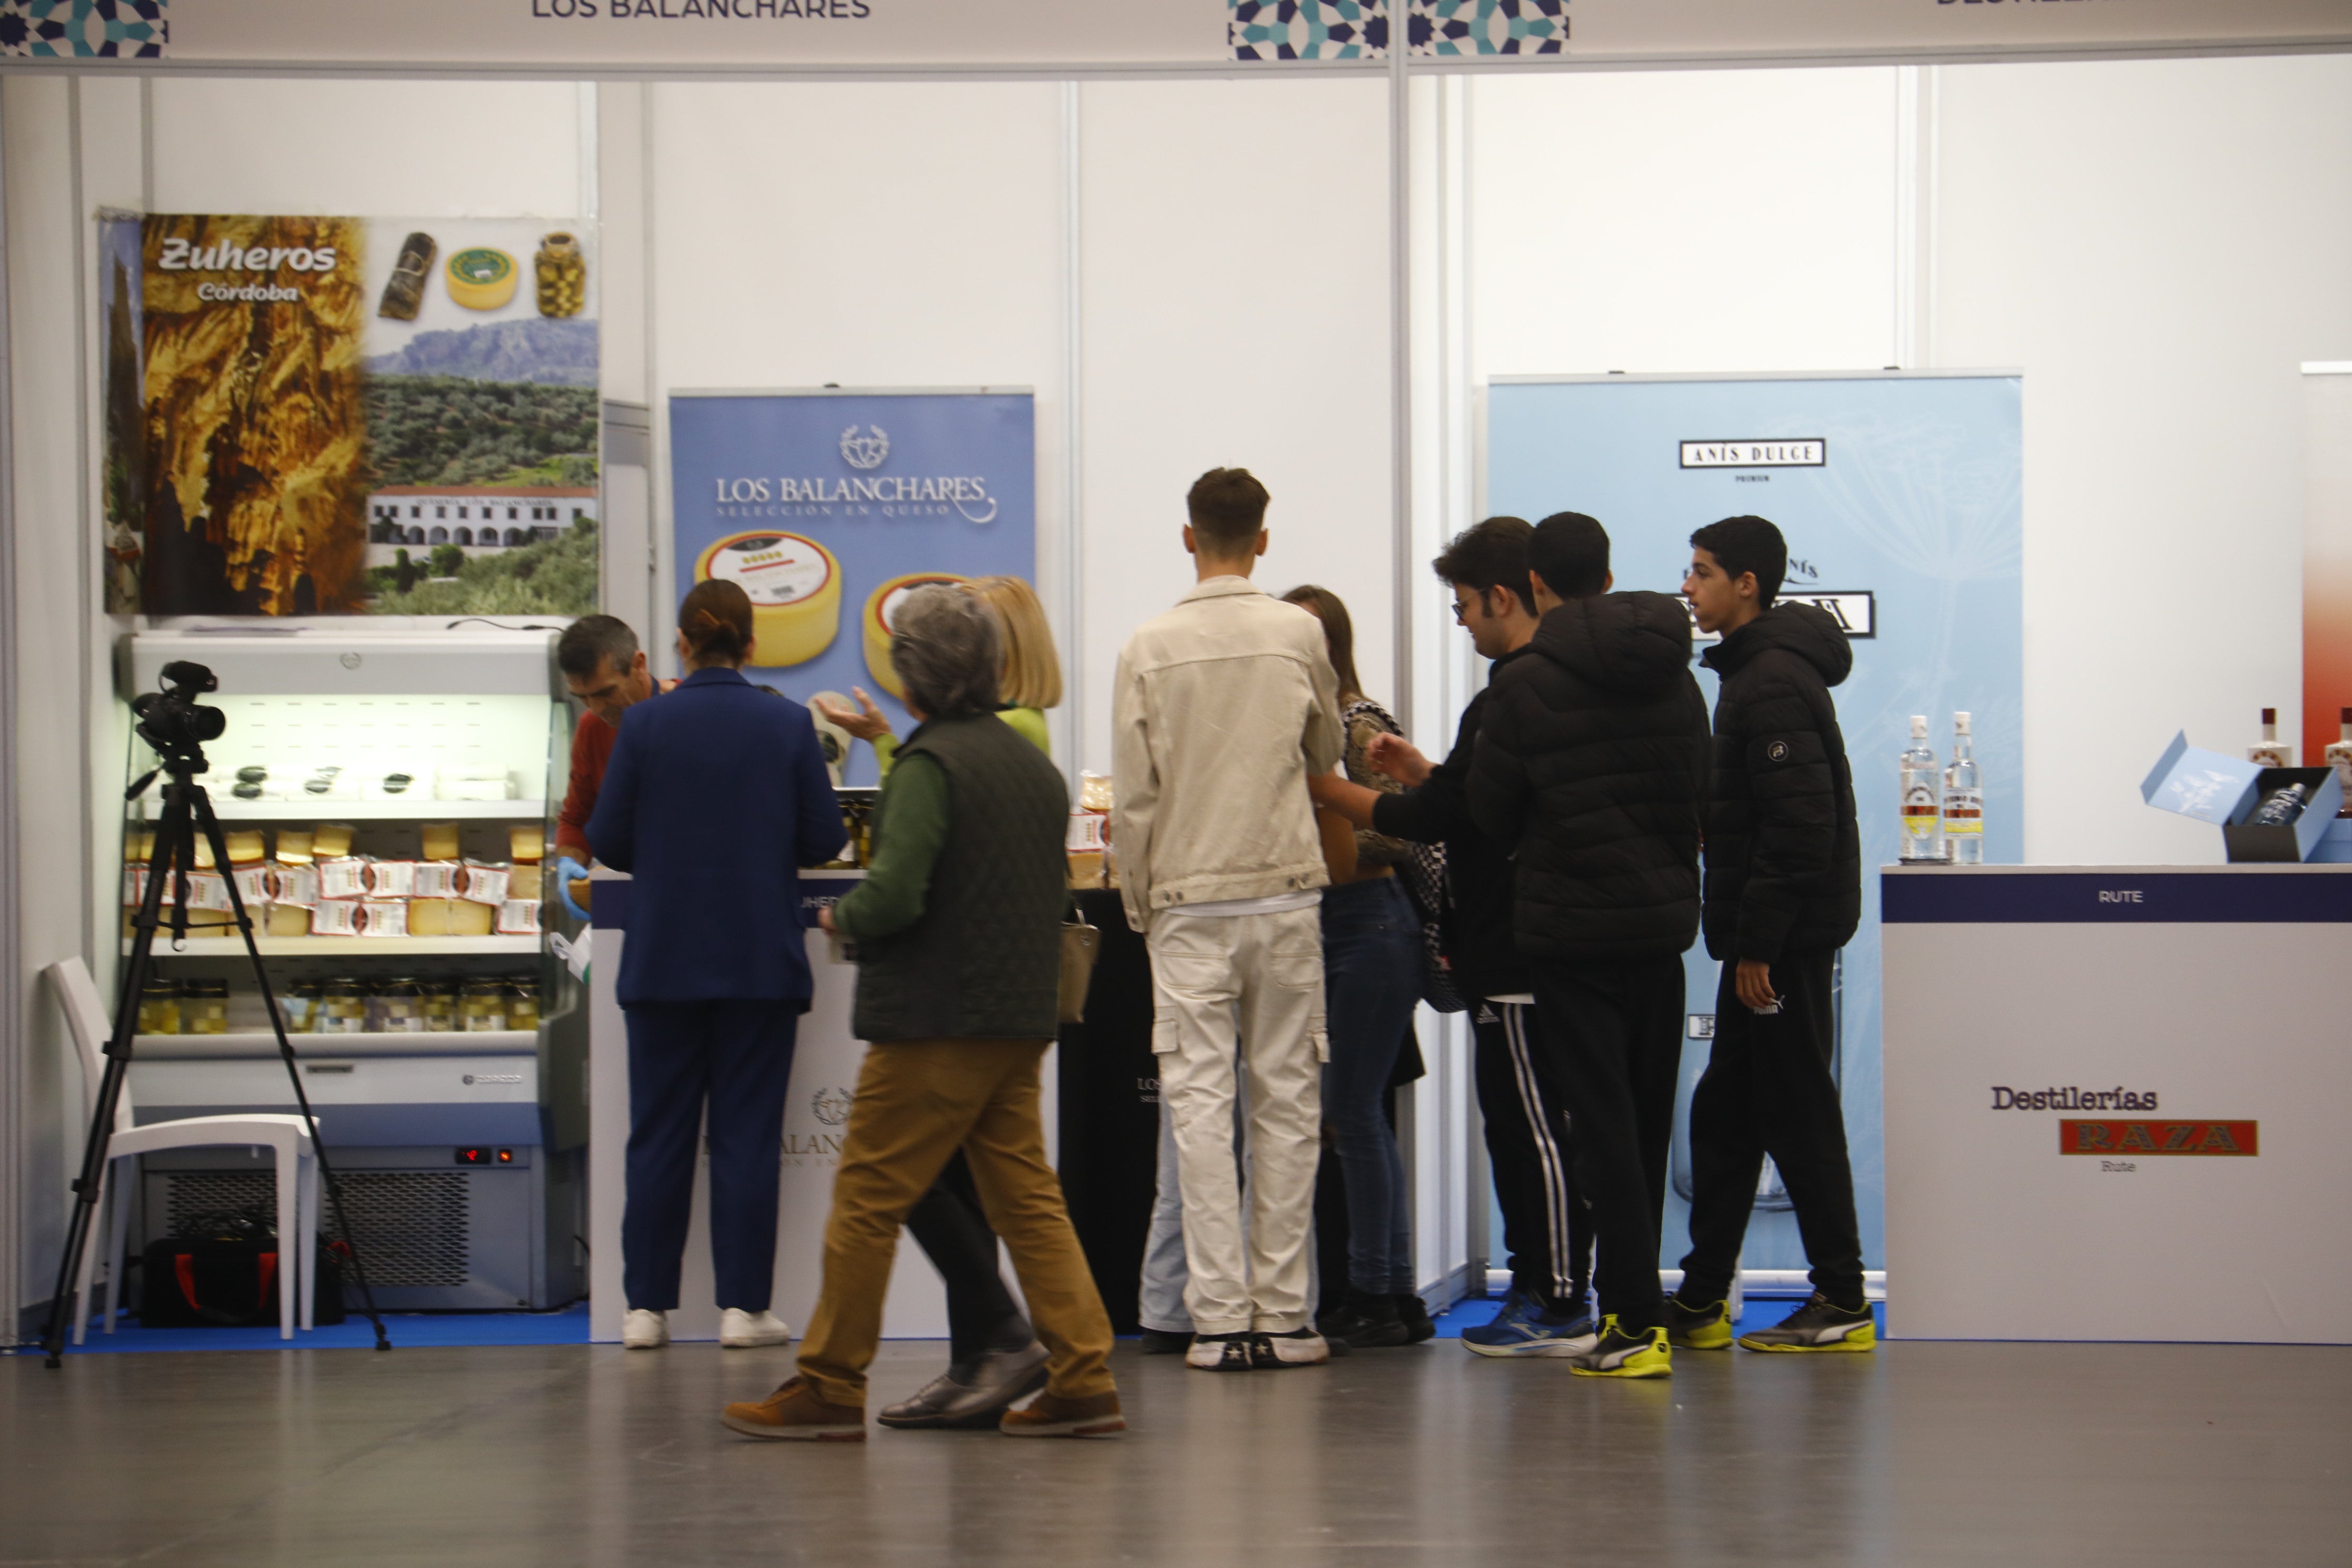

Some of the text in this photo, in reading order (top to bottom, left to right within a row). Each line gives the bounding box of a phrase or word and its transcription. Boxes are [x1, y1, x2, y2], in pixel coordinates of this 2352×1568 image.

[532, 0, 870, 18] LOS BALANCHARES
[159, 238, 336, 271] Zuheros
[197, 281, 299, 301] Córdoba
[717, 477, 997, 522] LOS BALANCHARES
[845, 504, 869, 516] EN
[883, 504, 949, 517] QUESO
[1789, 558, 1818, 578] NÍS
[2099, 890, 2143, 903] RUTE
[1991, 1086, 2158, 1111] Destilerías
[2075, 1123, 2241, 1152] RAZA
[2101, 1161, 2137, 1172] Rute
